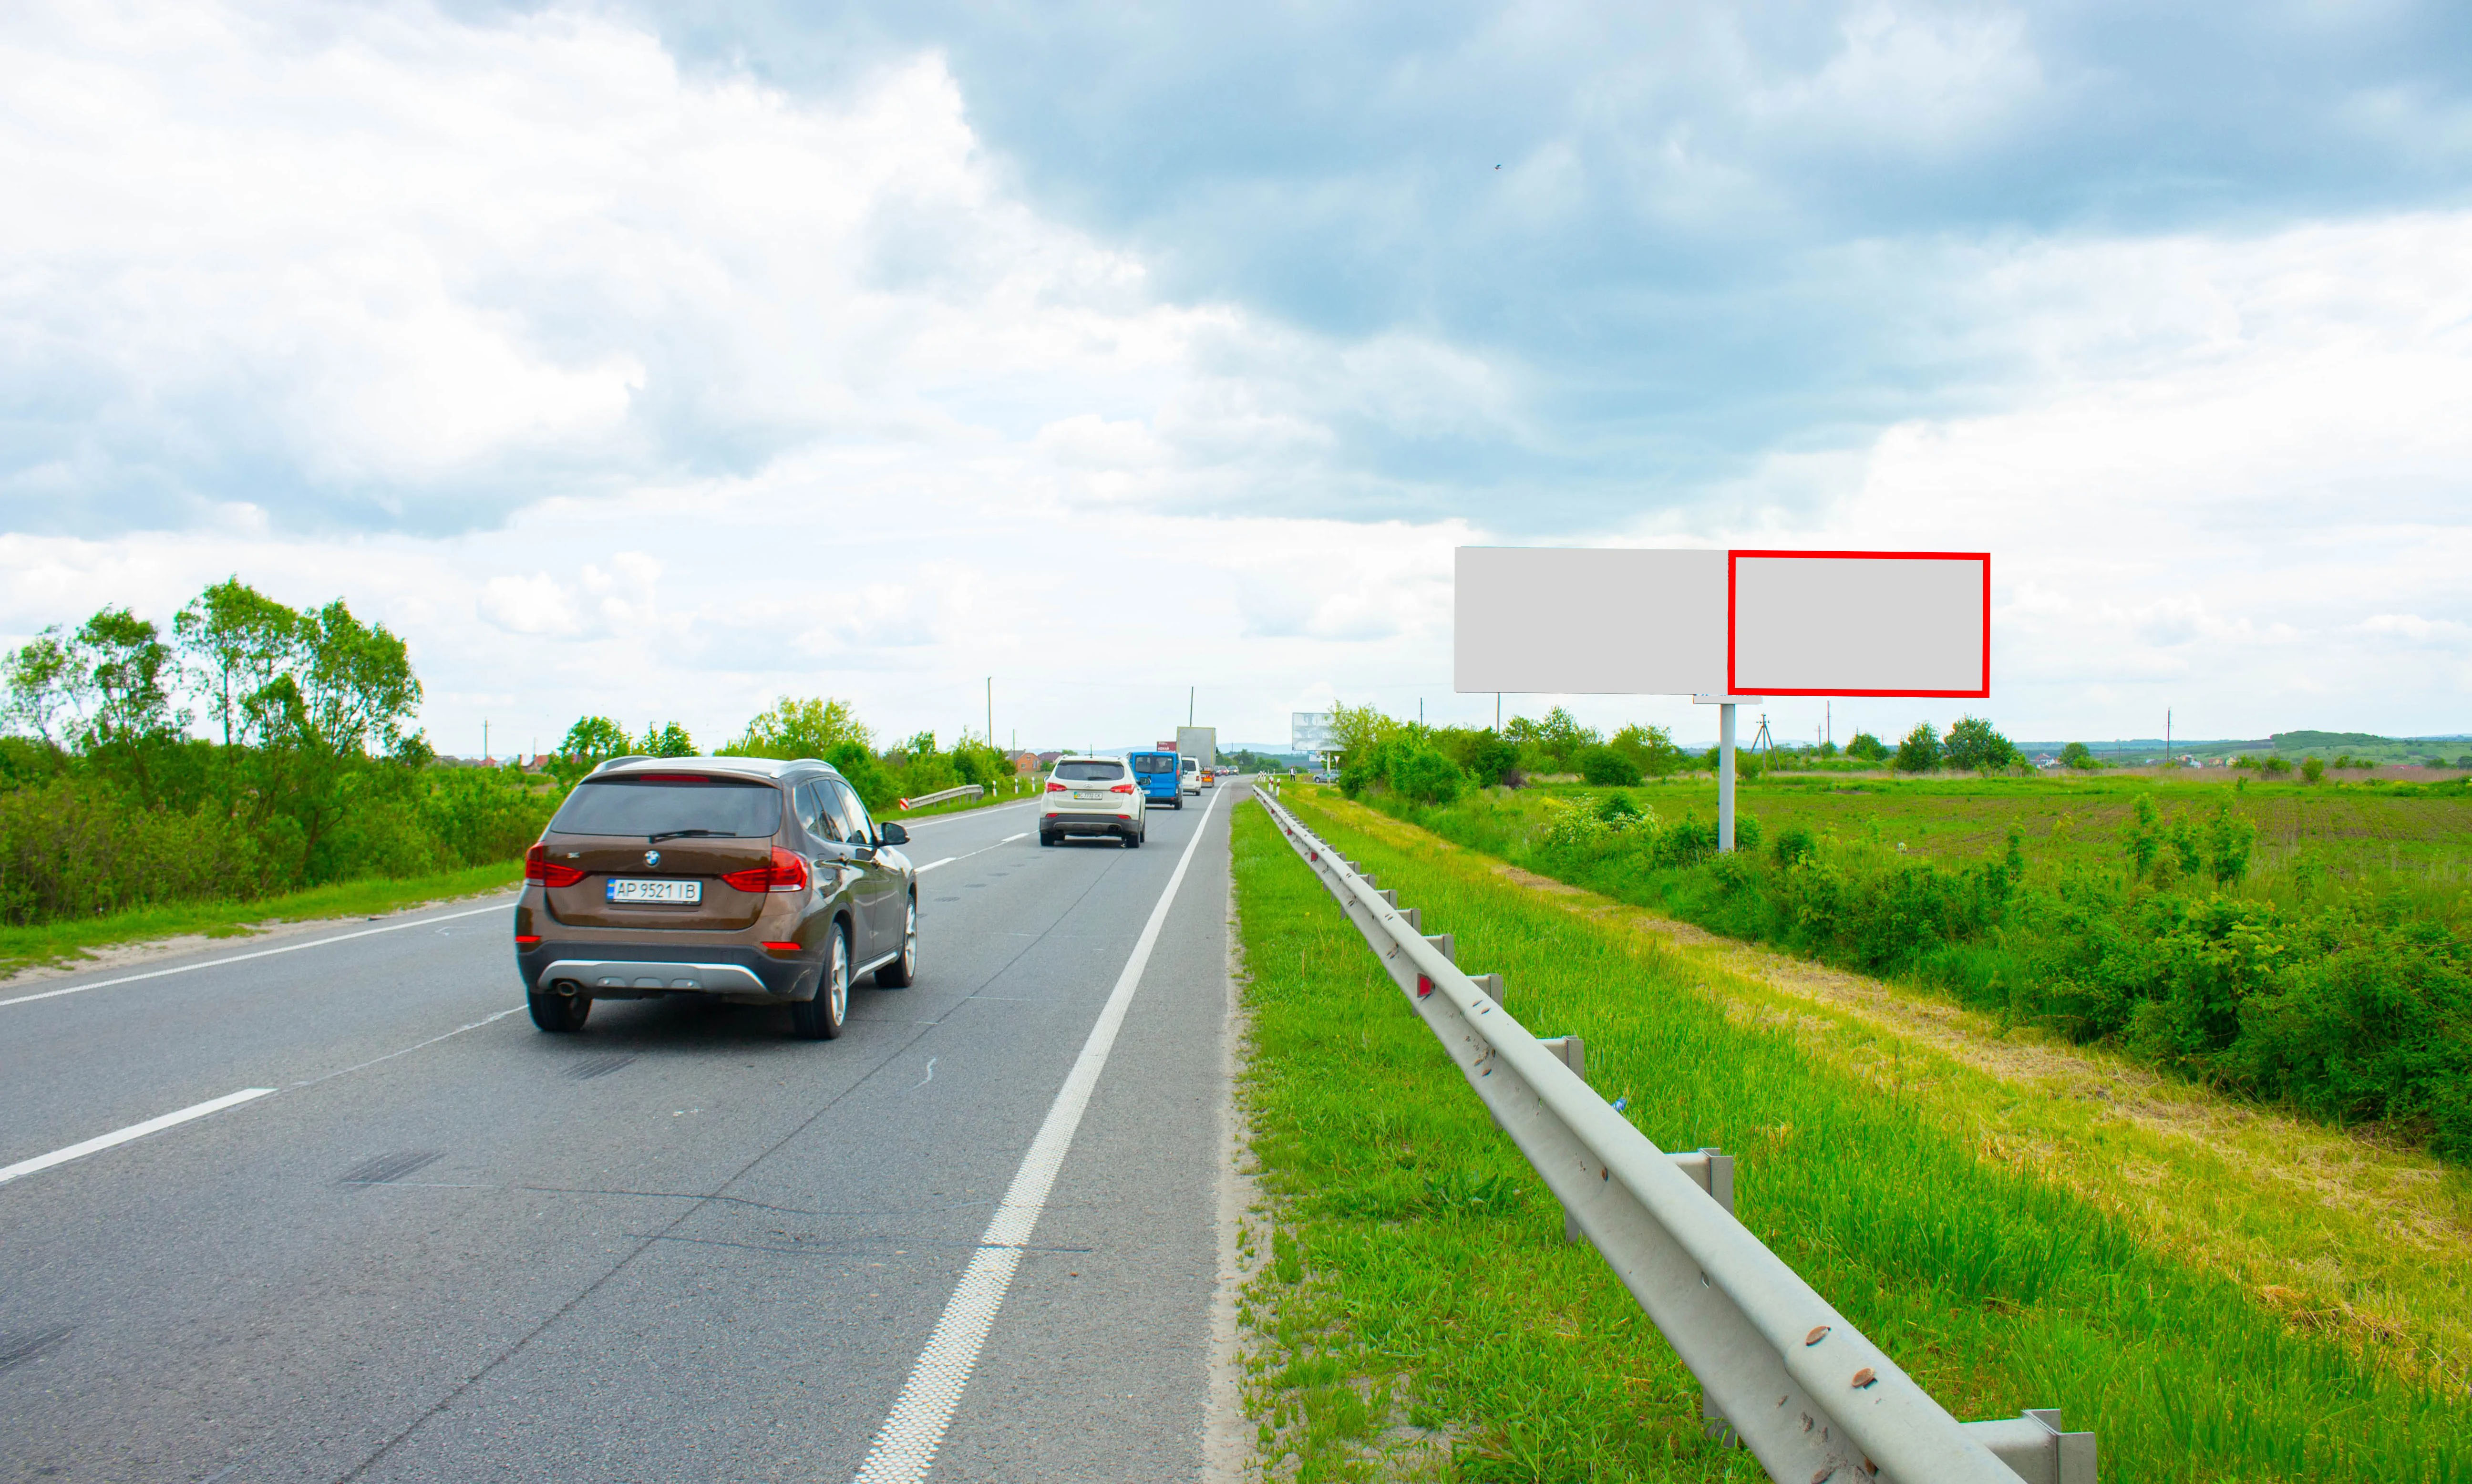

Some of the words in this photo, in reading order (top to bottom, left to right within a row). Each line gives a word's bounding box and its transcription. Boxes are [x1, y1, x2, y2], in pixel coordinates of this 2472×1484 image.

[617, 882, 637, 897] AP
[640, 883, 672, 898] 9521
[679, 884, 696, 899] IB
